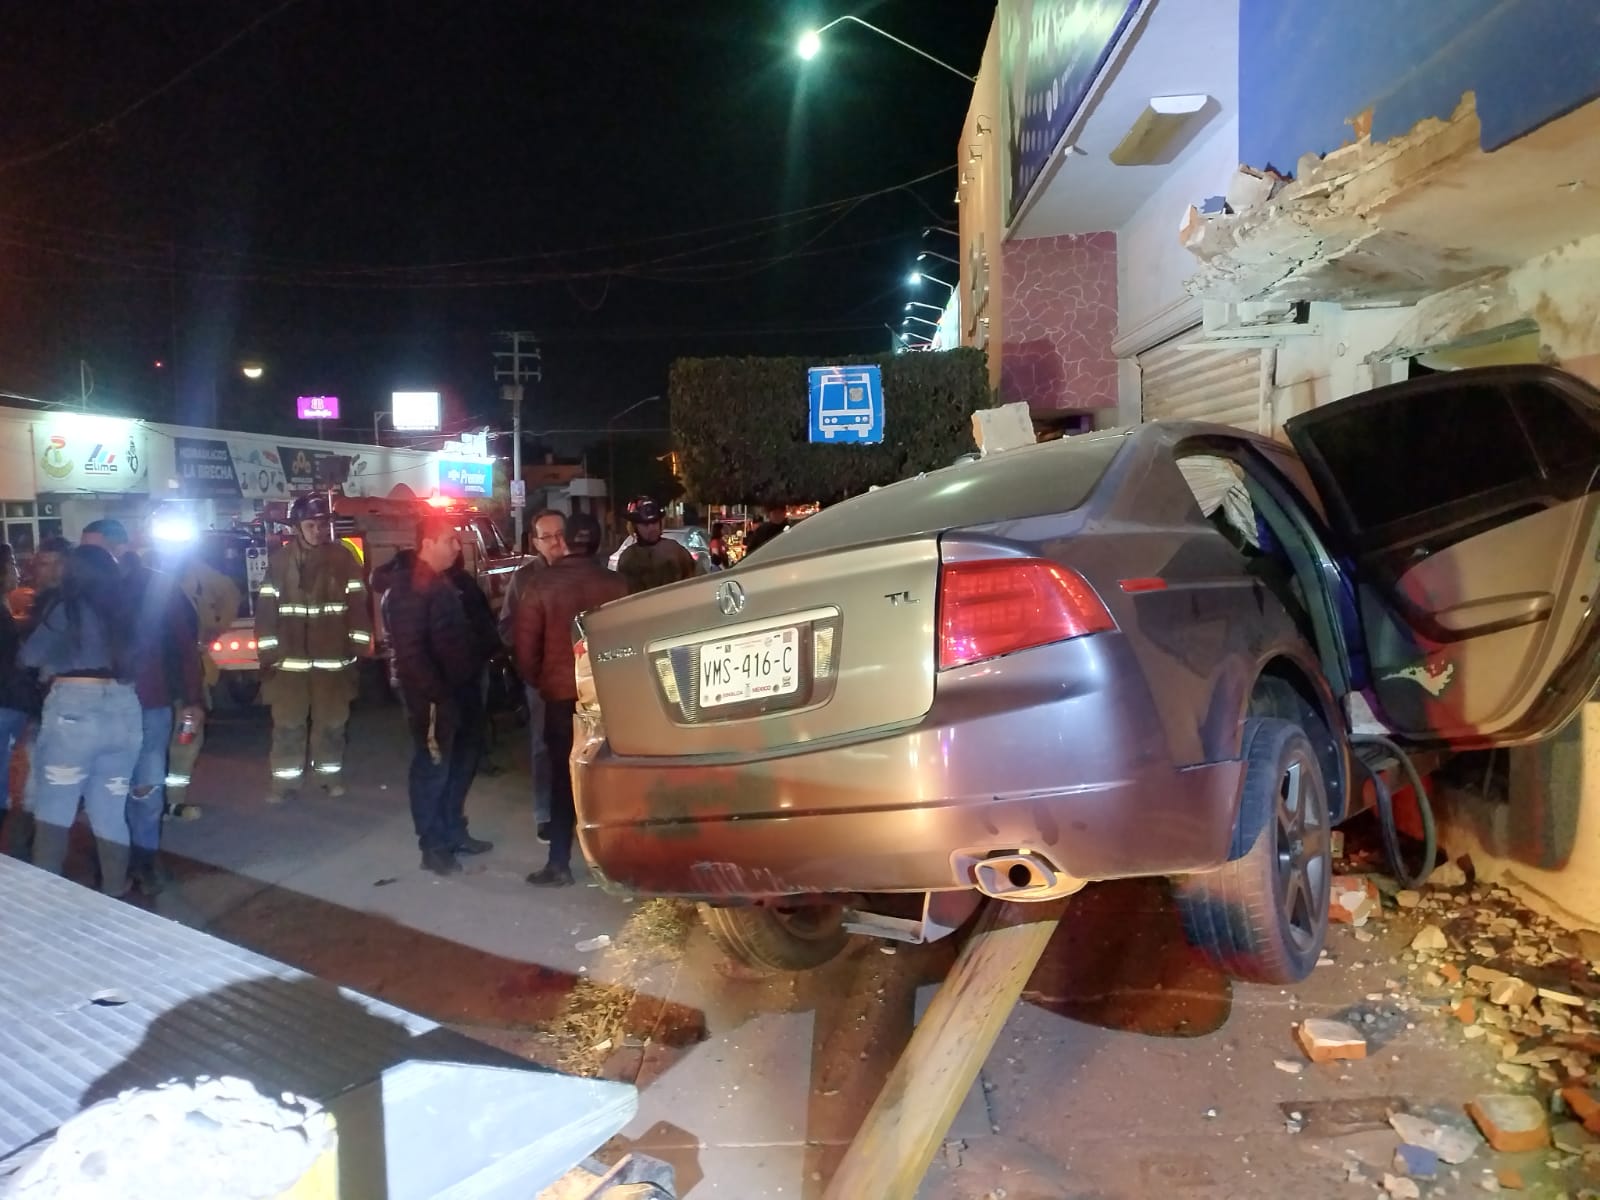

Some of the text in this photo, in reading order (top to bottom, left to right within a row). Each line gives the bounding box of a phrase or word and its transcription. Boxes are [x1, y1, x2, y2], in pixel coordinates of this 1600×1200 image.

[183, 463, 196, 479] LA
[884, 591, 920, 607] TL
[703, 646, 792, 687] VMS-416-C
